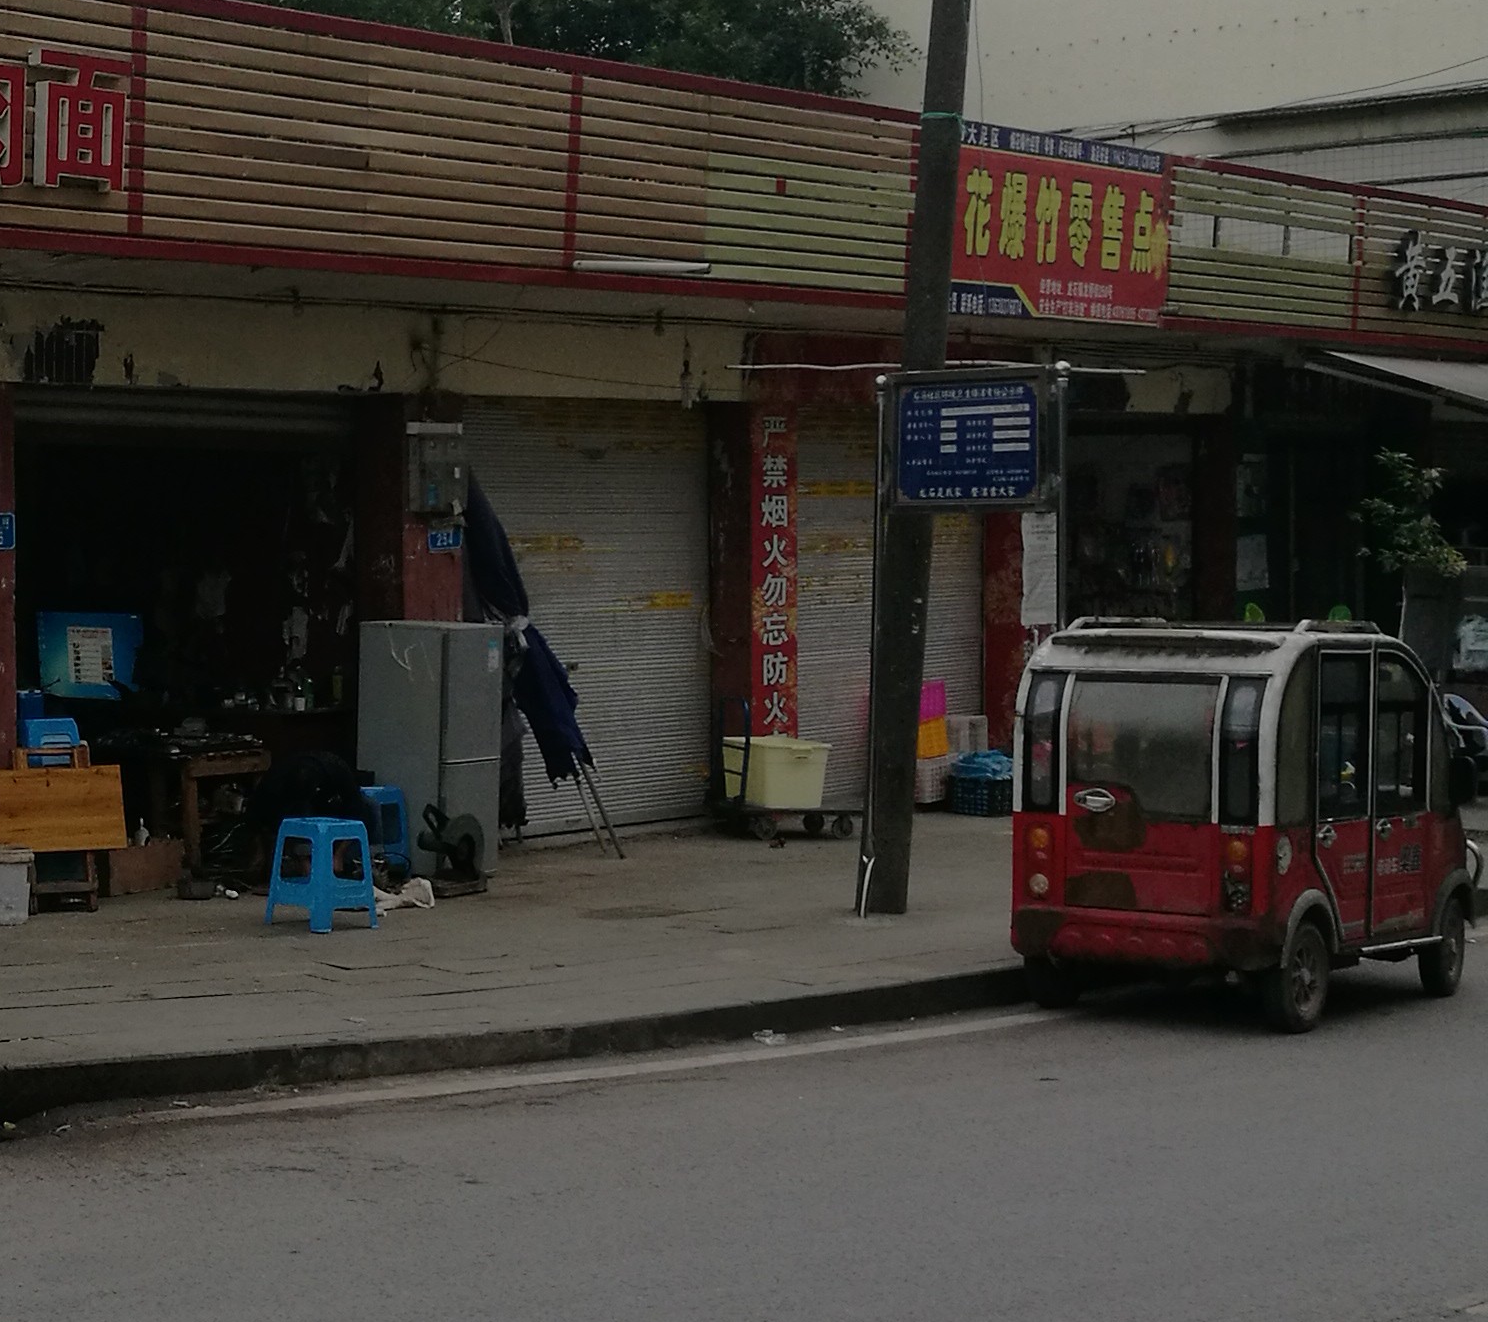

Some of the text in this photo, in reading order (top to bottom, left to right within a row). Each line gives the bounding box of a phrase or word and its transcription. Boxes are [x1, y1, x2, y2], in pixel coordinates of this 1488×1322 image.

[760, 416, 790, 737] 严禁烟火勿忘防火
